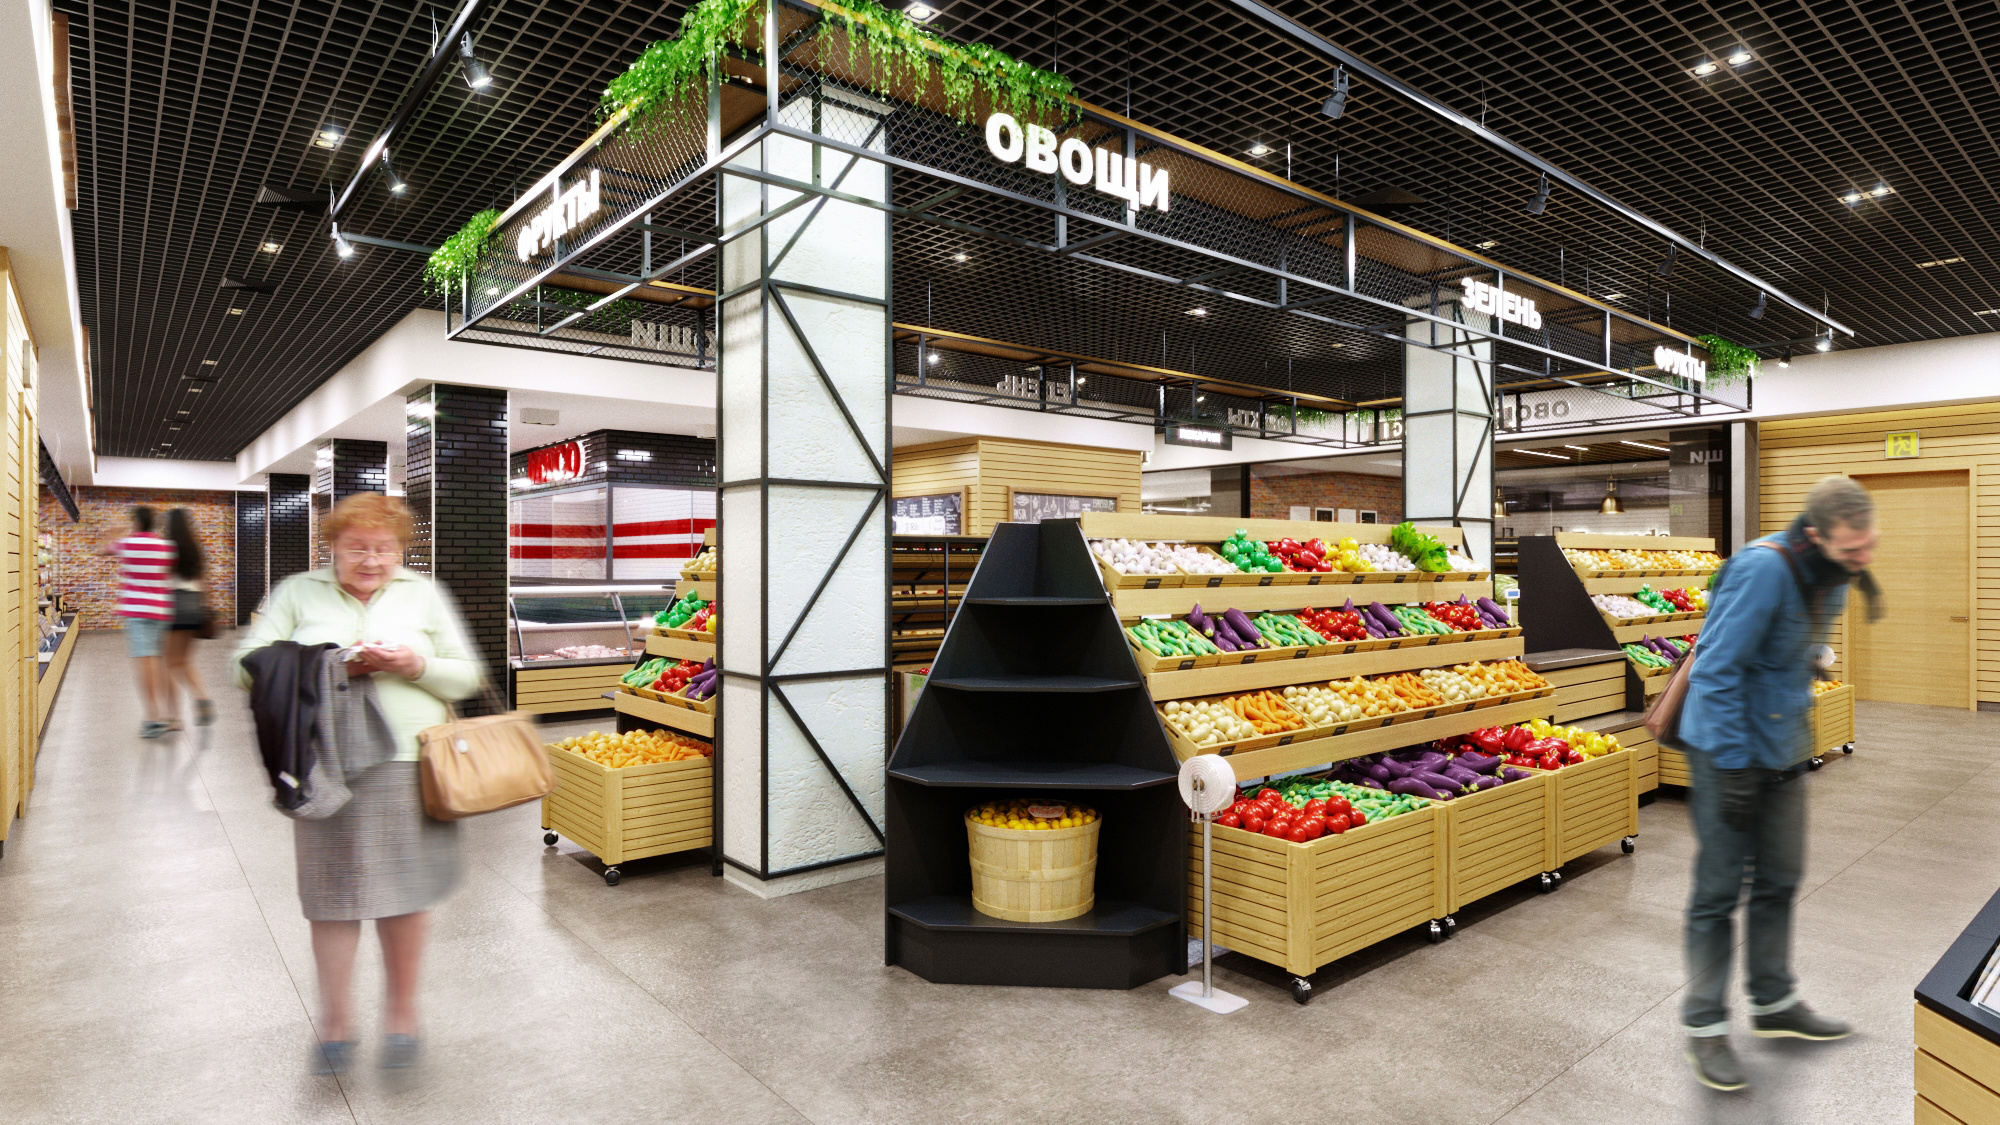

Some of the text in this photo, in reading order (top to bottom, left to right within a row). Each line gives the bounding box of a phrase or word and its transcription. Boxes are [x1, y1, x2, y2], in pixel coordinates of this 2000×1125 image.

[985, 112, 1168, 212] ОВОЩИ
[517, 168, 600, 263] ФРУКТЫ
[1461, 277, 1542, 330] ЗЕЛЕНЬ
[1654, 345, 1706, 383] ФРУКТЫ
